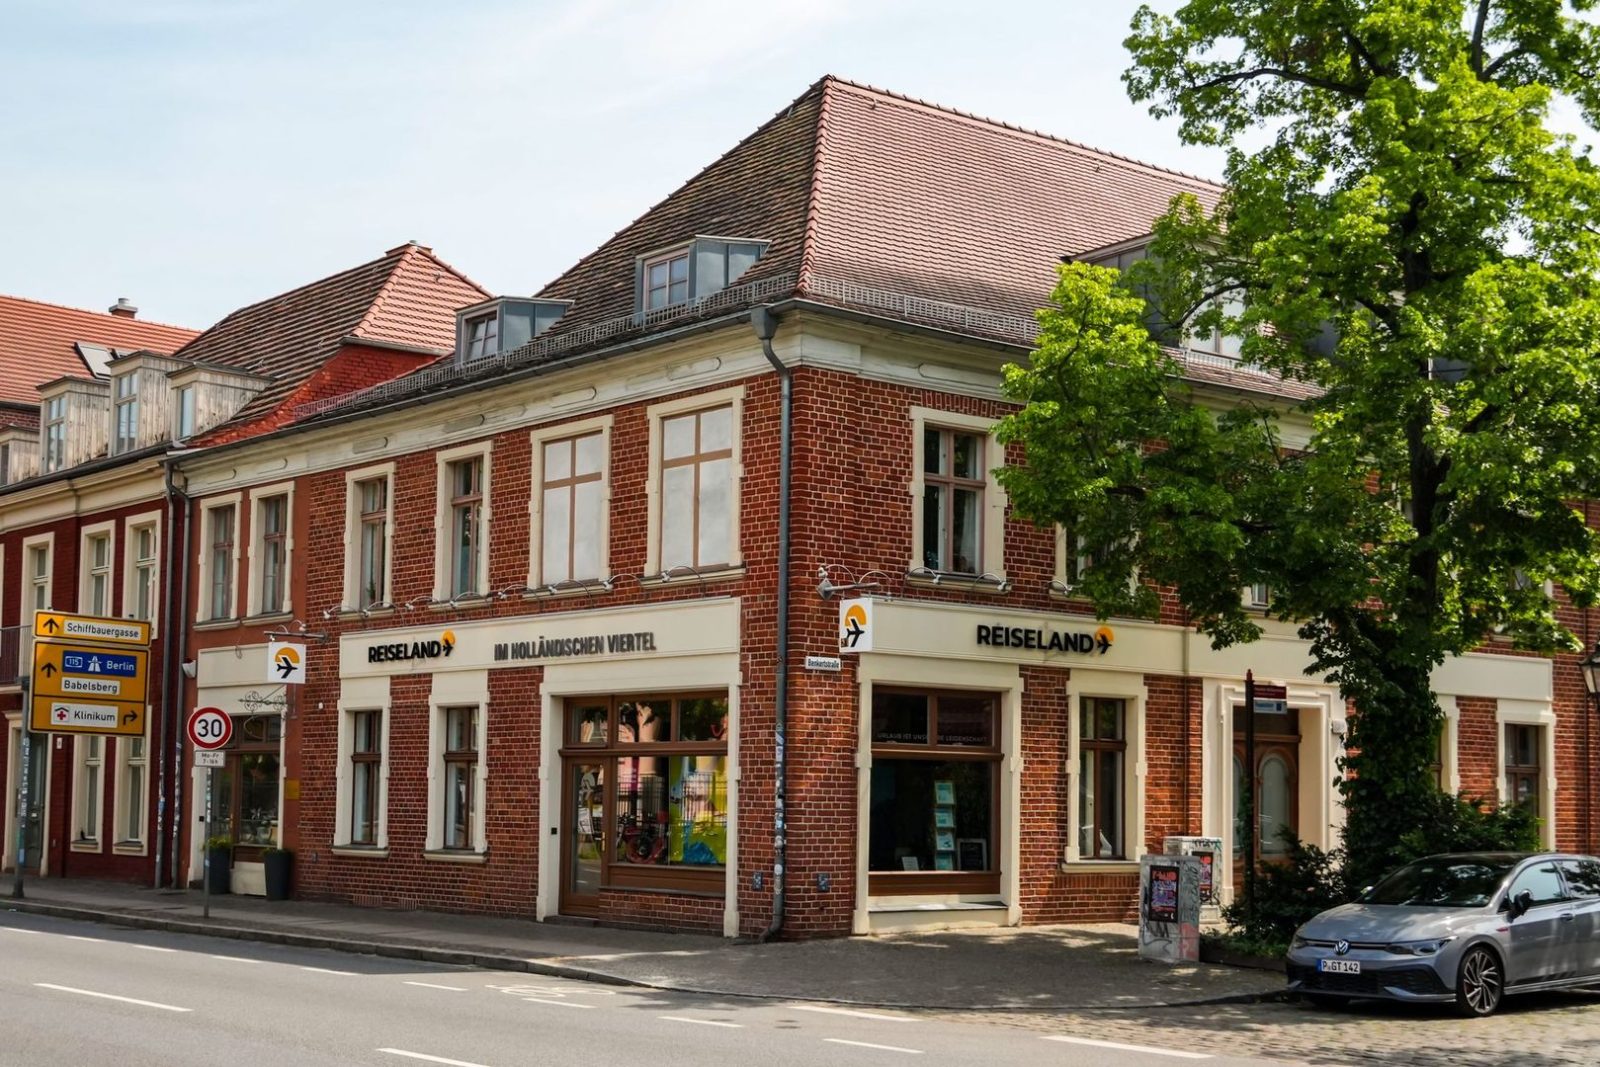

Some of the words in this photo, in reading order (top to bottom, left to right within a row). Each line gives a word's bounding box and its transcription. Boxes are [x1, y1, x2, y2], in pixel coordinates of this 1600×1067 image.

[67, 622, 139, 637] Schiffbauergasse
[494, 643, 509, 661] IM
[511, 636, 605, 660] HOLLÄNDISCHEN
[607, 632, 657, 653] VIERTEL
[977, 625, 1095, 653] REISELAND
[368, 640, 442, 663] REISELAND
[68, 658, 80, 666] 115
[106, 660, 135, 671] Berlin
[64, 680, 118, 693] Babelsberg
[74, 710, 116, 722] Klinikum
[197, 718, 222, 738] 30
[1322, 961, 1328, 970] P
[1343, 962, 1359, 973] 142
